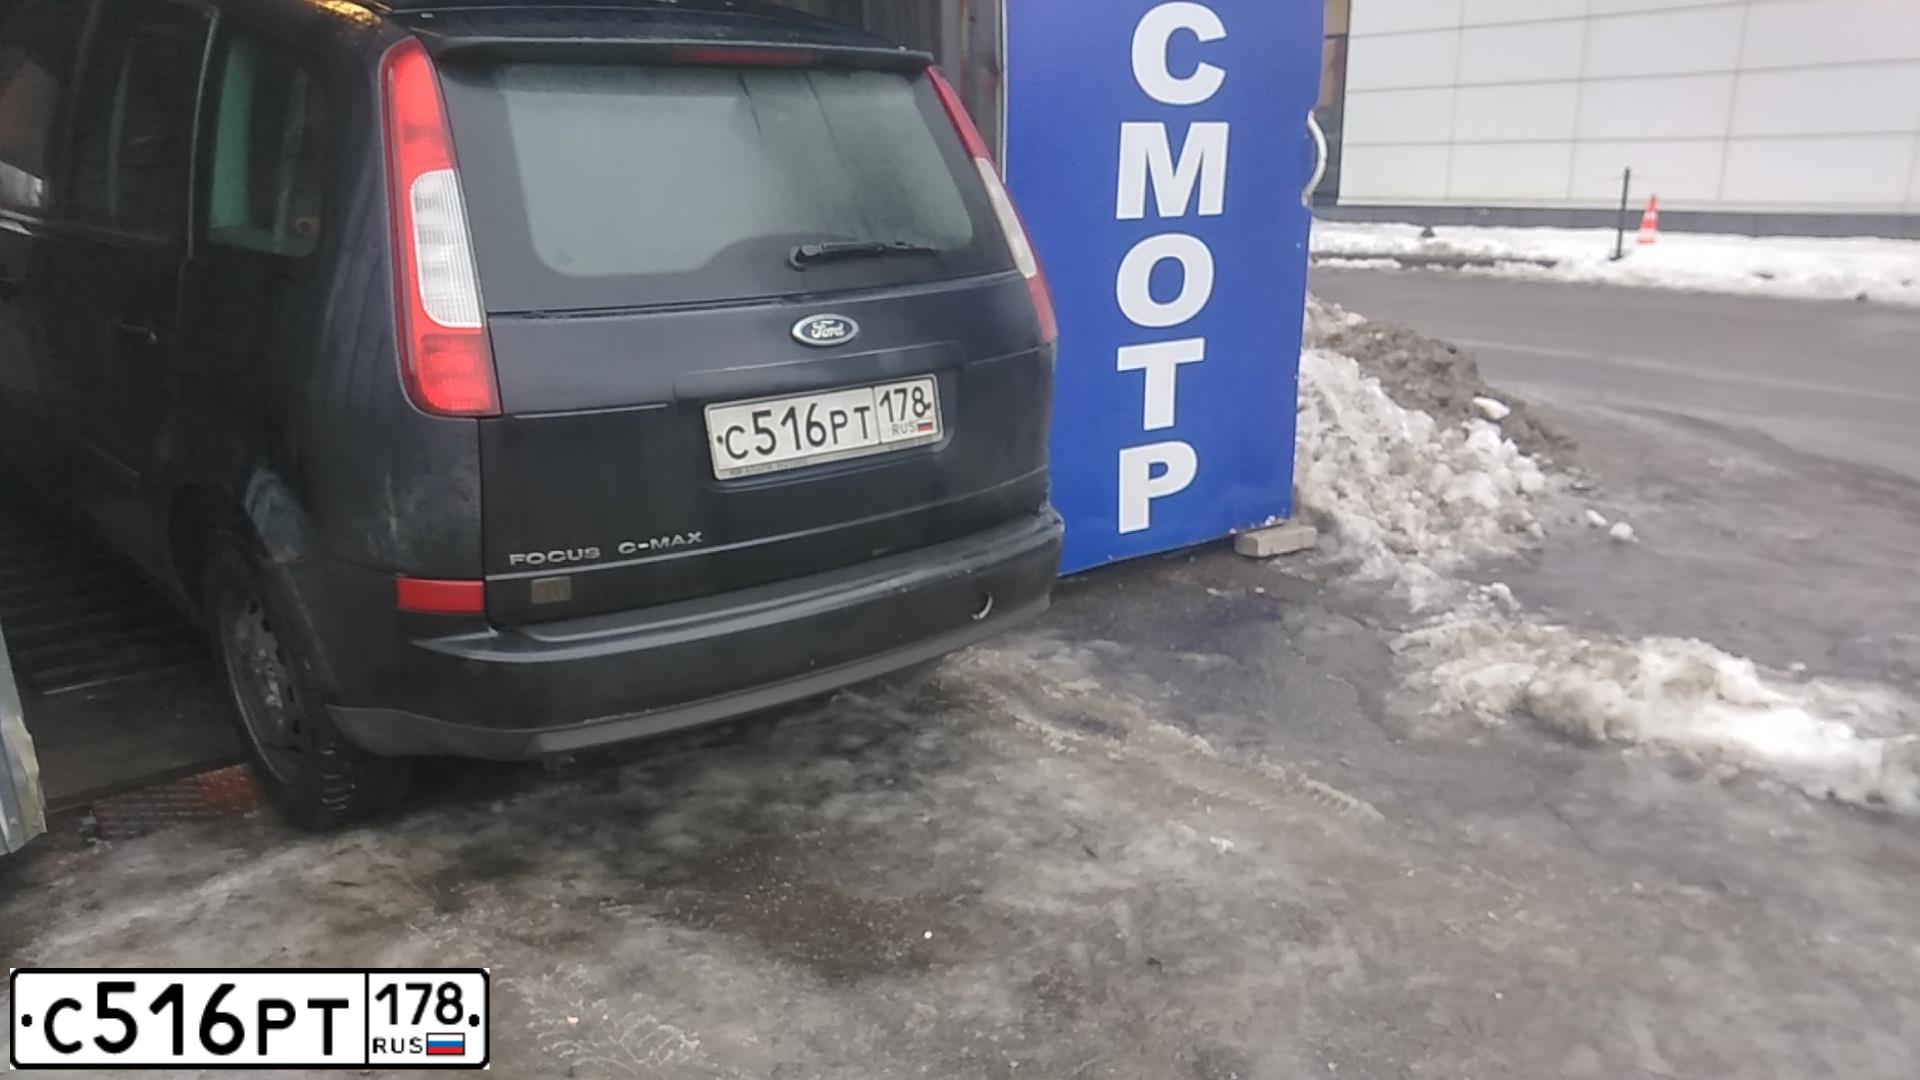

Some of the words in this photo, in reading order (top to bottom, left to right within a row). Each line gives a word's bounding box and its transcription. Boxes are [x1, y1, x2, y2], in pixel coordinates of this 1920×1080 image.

[811, 319, 845, 338] Ford
[879, 386, 926, 423] 178
[891, 423, 916, 434] RUS
[509, 547, 601, 566] FOCUS
[618, 531, 703, 554] C-MAX
